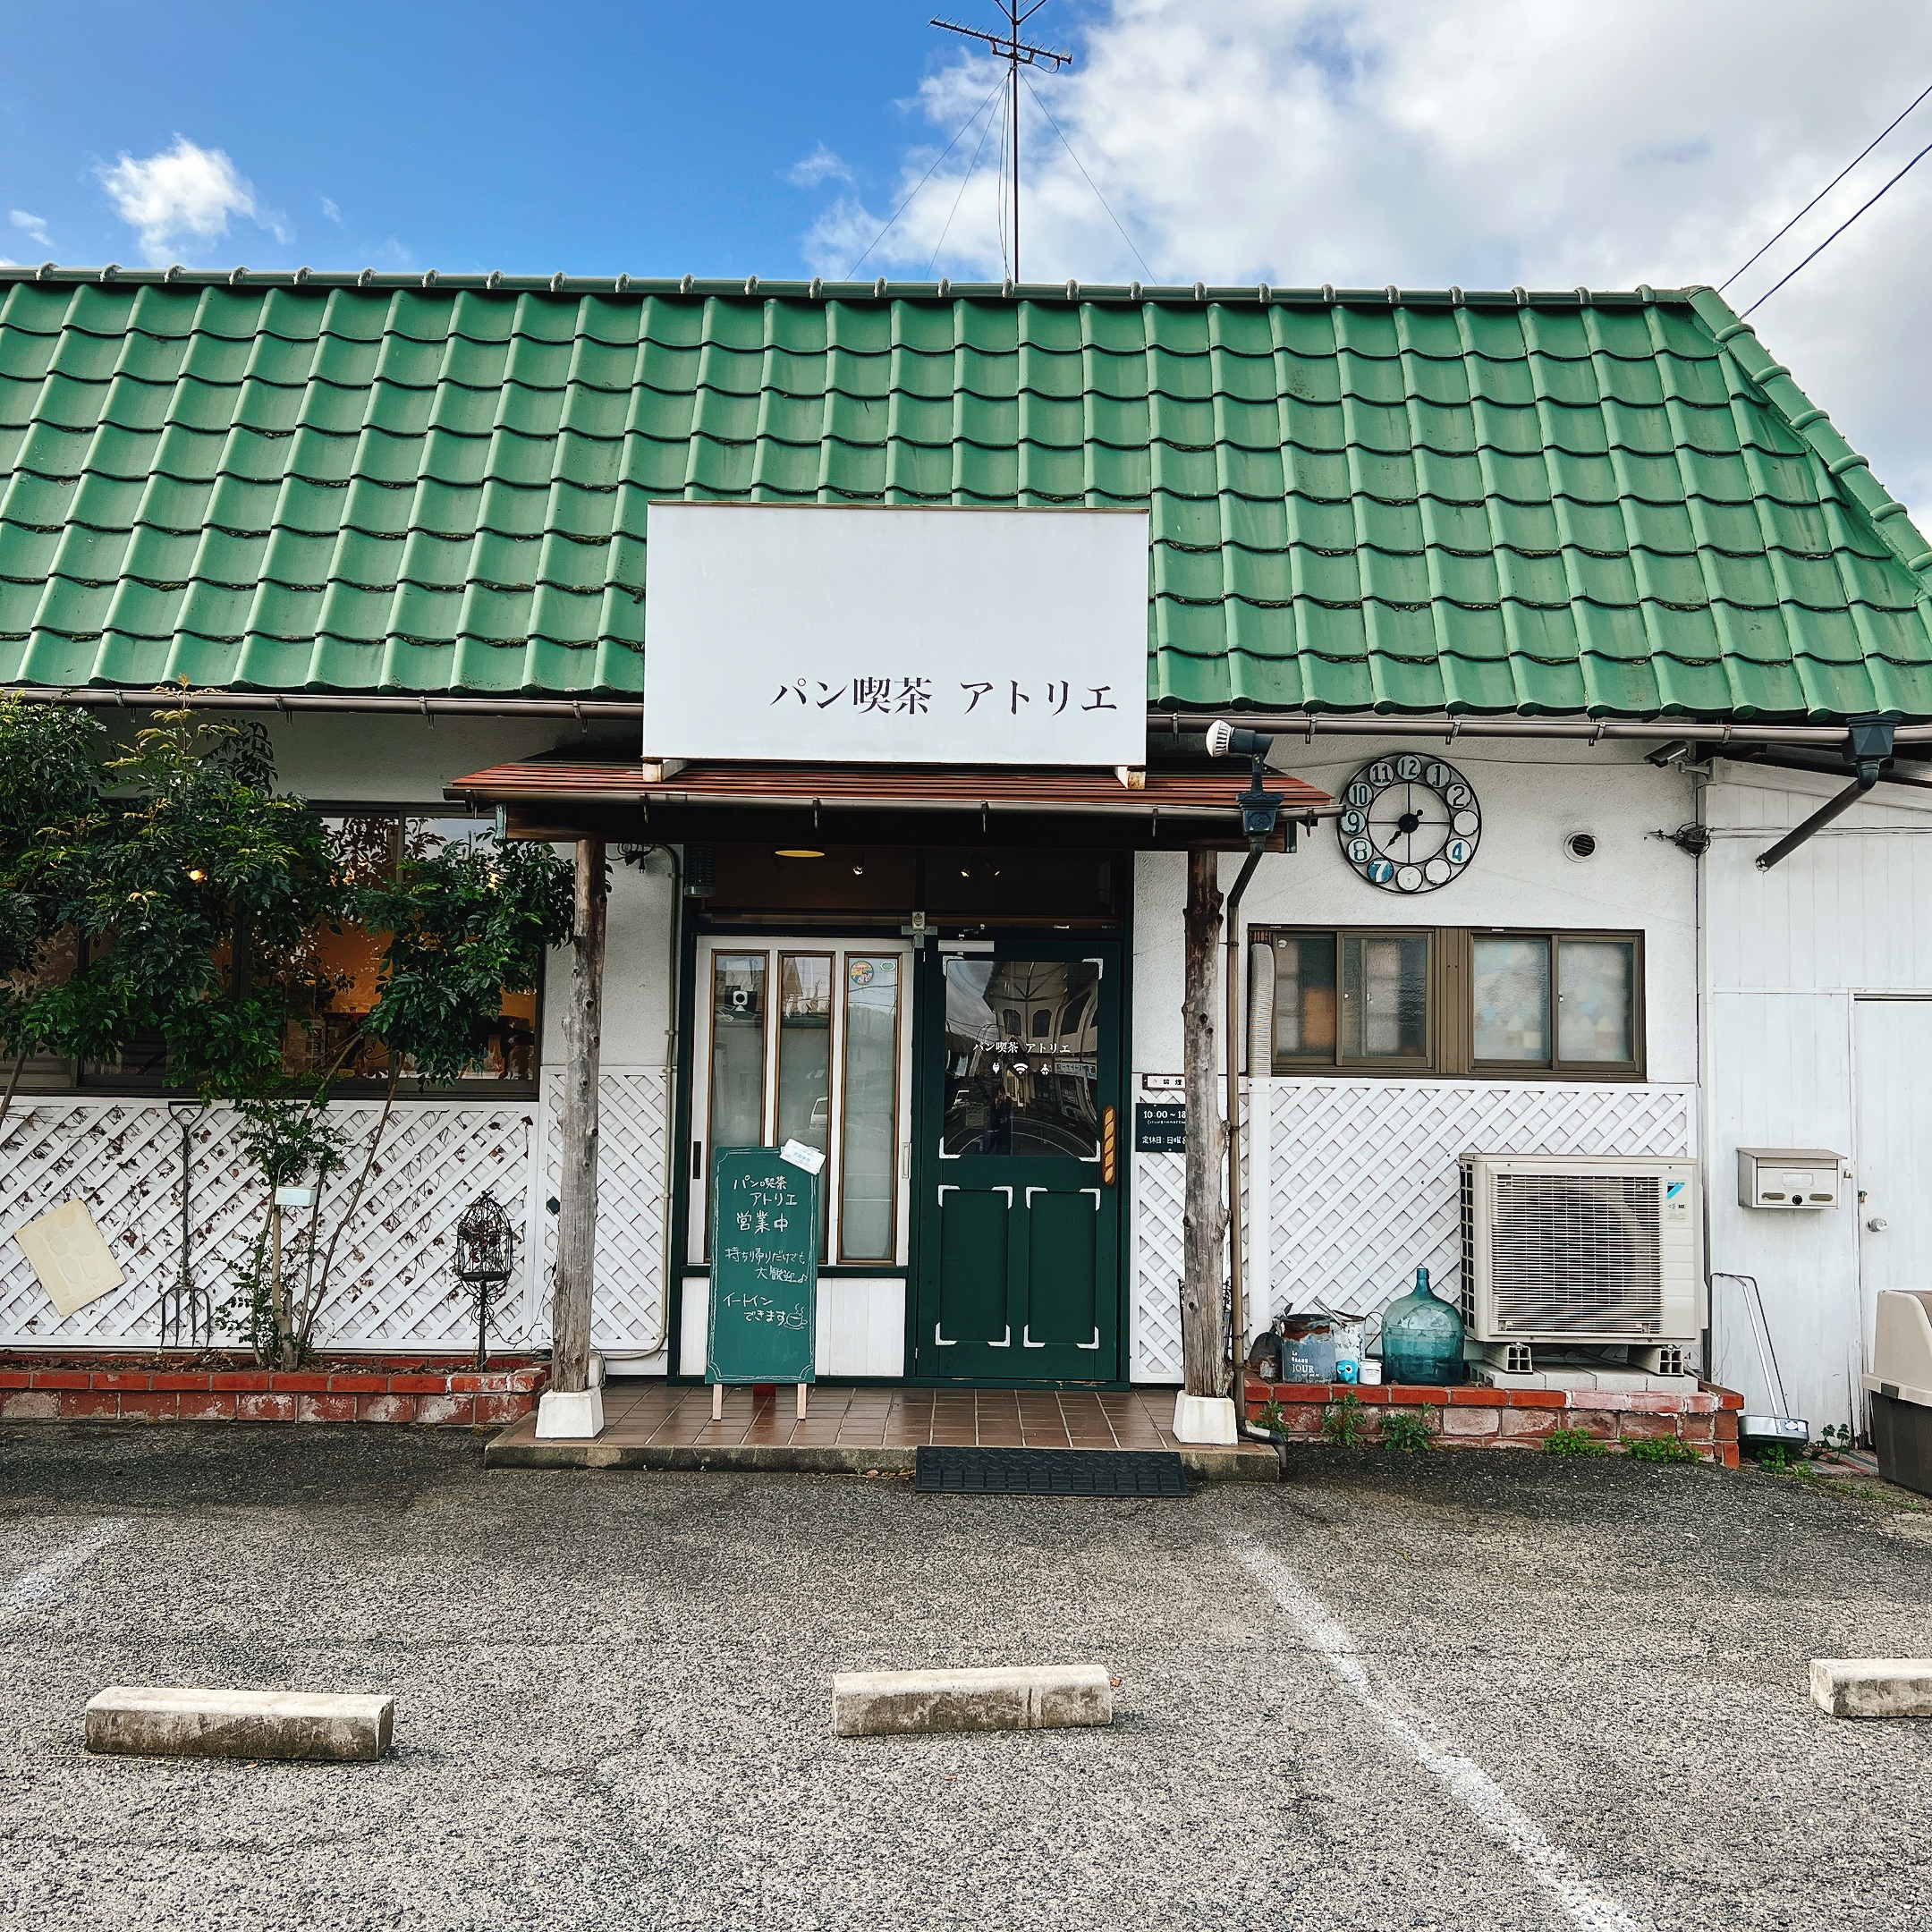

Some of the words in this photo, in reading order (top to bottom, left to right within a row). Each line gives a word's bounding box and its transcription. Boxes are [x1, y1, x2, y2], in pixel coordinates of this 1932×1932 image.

[770, 677, 933, 715] パン喫茶
[961, 680, 1118, 716] アトリエ
[1372, 766, 1390, 784] 11
[1401, 759, 1418, 776] 12
[1433, 766, 1441, 786] 1
[1353, 785, 1368, 805] 10
[1453, 786, 1465, 806] 2
[1347, 811, 1360, 833] 9
[1353, 841, 1368, 861] 8
[1452, 842, 1462, 861] 4
[1374, 860, 1387, 882] 7
[973, 1041, 1018, 1053] パン喫茶
[1026, 1043, 1071, 1054] アトリエ
[750, 1192, 798, 1207] アトリエ
[736, 1210, 788, 1233] 営業中
[724, 1247, 805, 1265] 持ち帰りだけでも
[723, 1292, 775, 1307] イートイン
[743, 1310, 786, 1326] できます
[1292, 1364, 1315, 1373] JOUR
